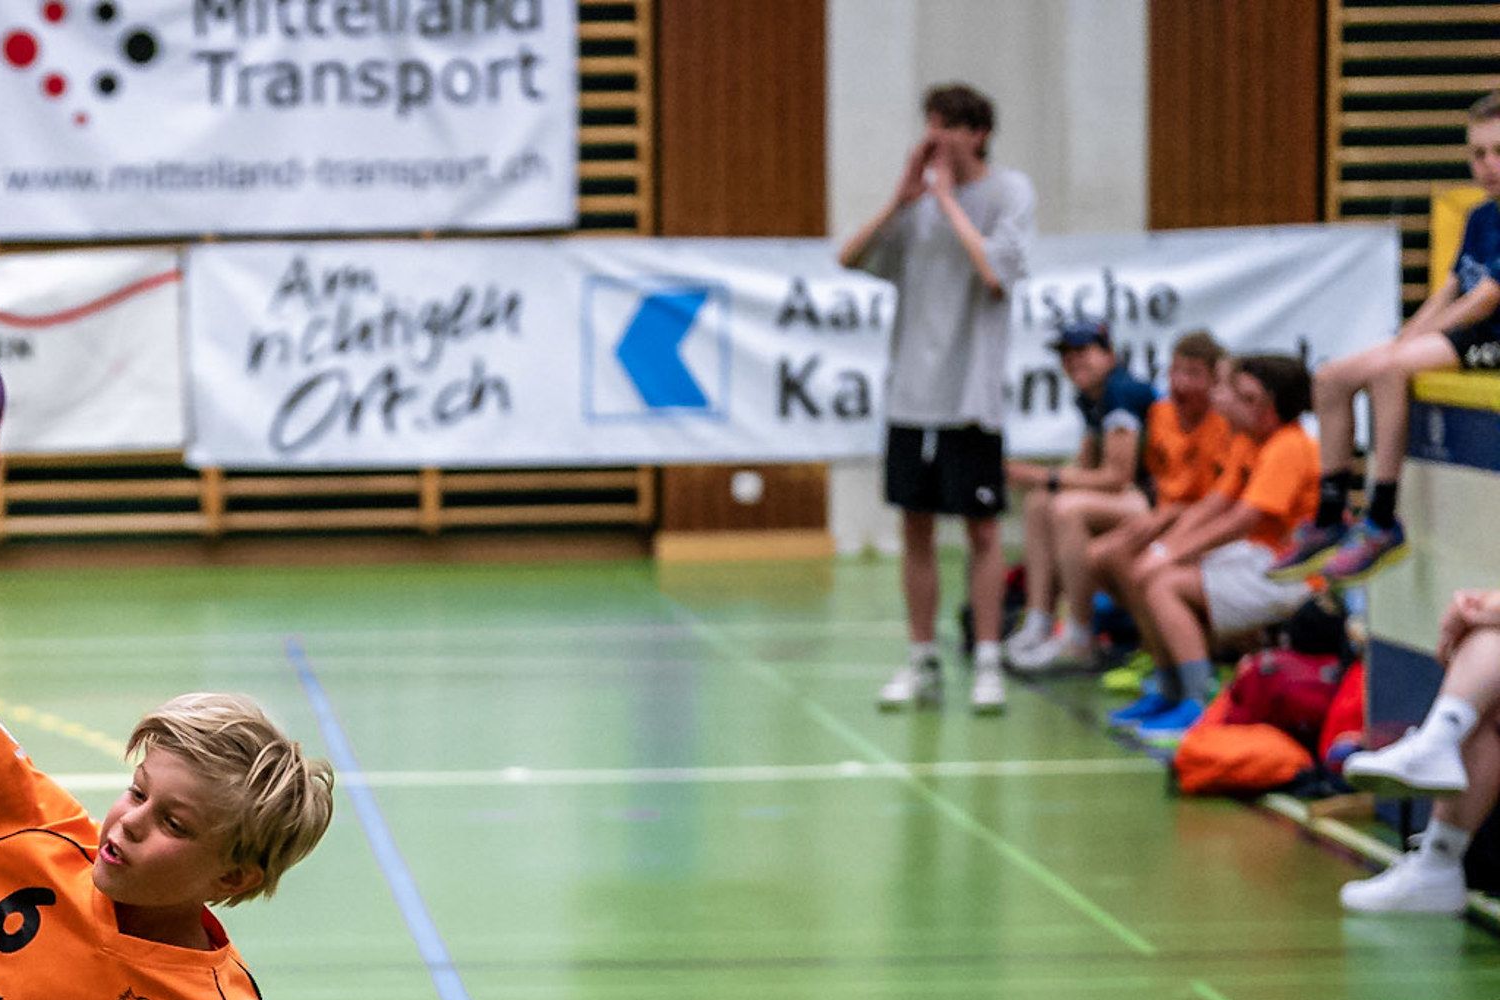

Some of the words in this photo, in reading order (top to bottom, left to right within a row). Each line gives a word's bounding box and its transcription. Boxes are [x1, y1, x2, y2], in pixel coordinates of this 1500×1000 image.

[192, 0, 543, 37] Mittelland
[195, 49, 544, 115] Transport
[267, 253, 380, 311] Am
[269, 358, 513, 453] Ort.ch
